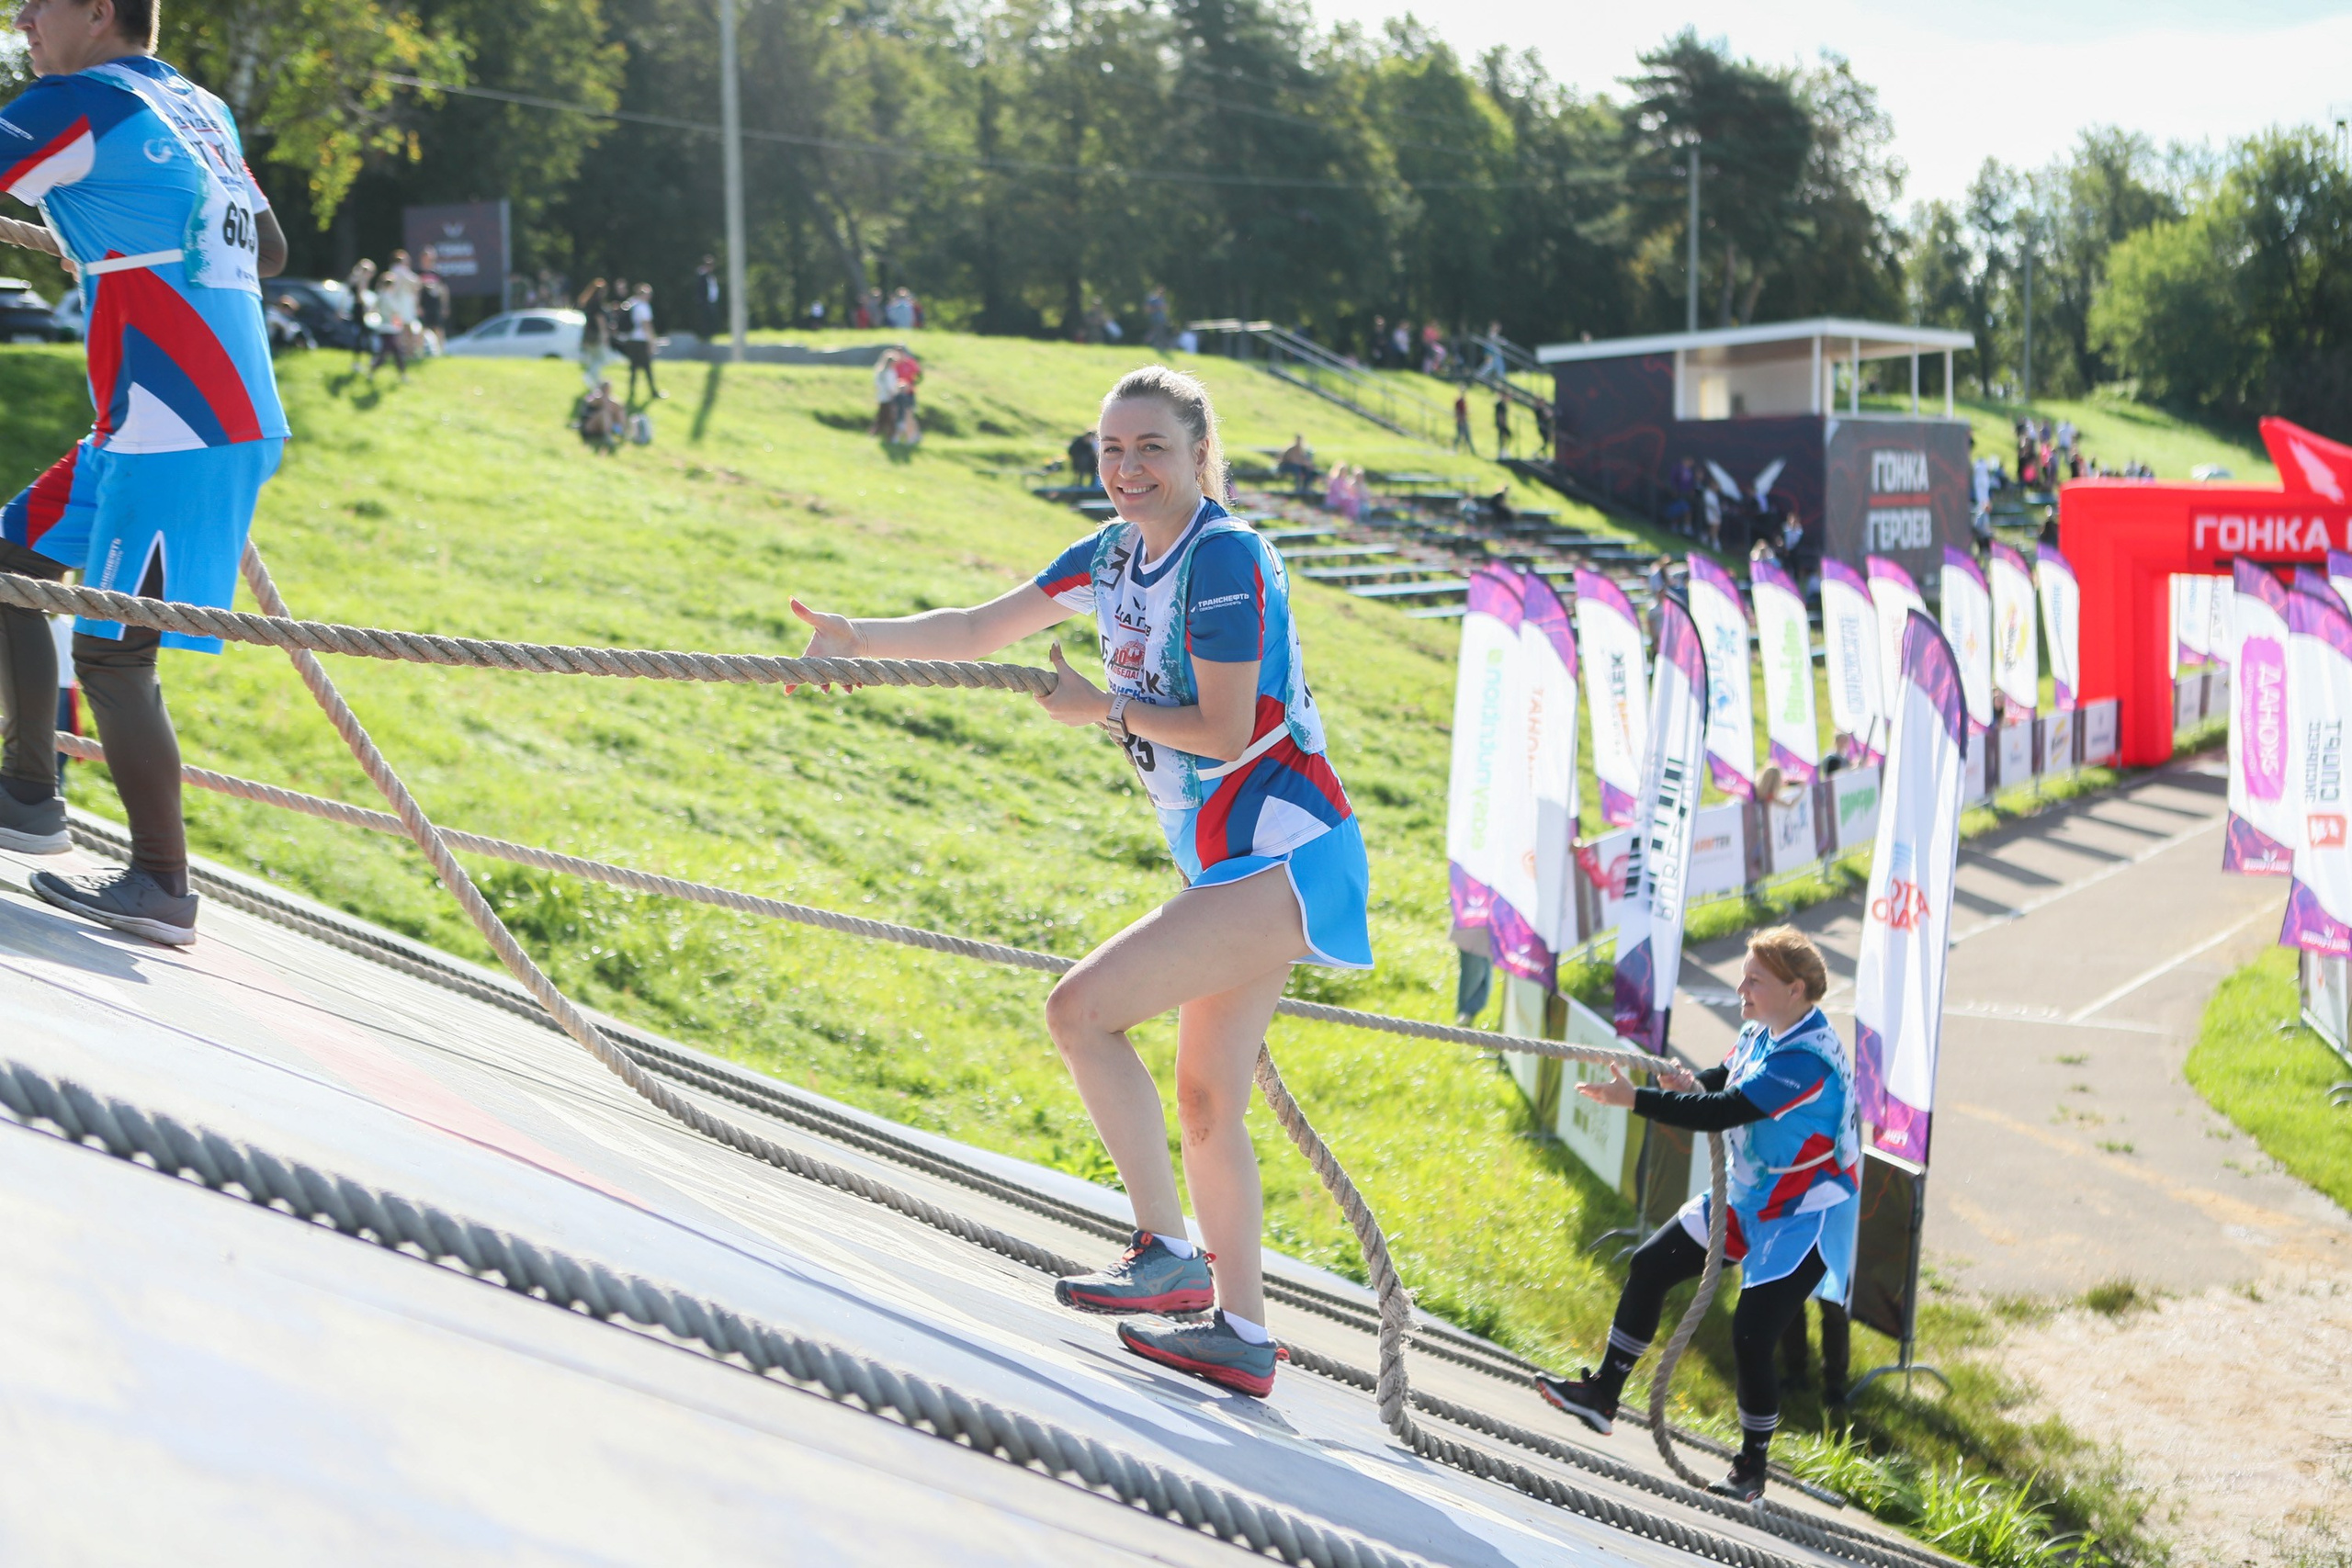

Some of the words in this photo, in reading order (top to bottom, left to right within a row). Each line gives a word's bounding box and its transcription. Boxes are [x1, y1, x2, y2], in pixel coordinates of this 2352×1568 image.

[1871, 450, 1929, 492] ГОНКА
[1866, 509, 1932, 552] ГЕРОЕВ
[2195, 515, 2332, 552] ГОНКА
[1198, 593, 1250, 608] ТРАНСНЕФТЬ
